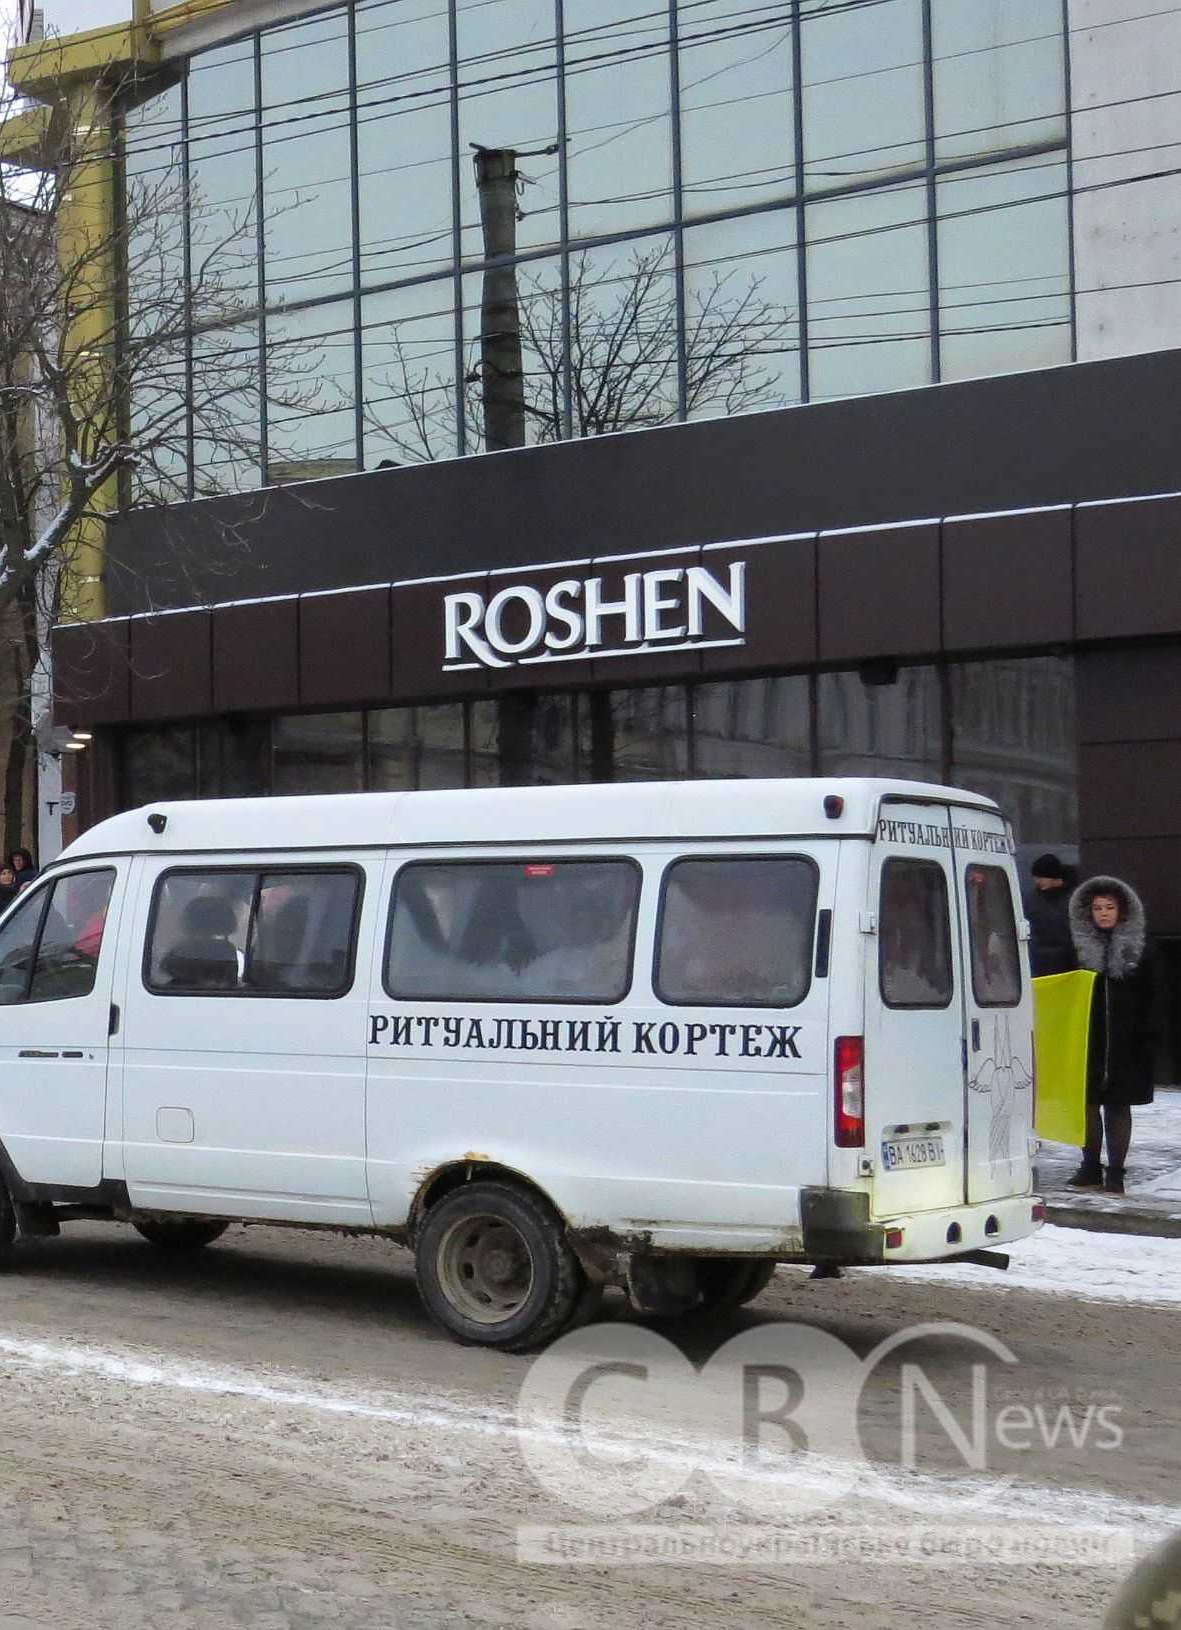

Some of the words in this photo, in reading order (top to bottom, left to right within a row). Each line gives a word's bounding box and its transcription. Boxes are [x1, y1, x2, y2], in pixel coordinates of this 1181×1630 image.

[443, 561, 747, 668] ROSHEN
[878, 819, 970, 849] РИТУАЛЬНИЙ
[367, 1014, 623, 1053] РИТУАЛЬНИЙ
[632, 1021, 804, 1059] КОРТЕЖ
